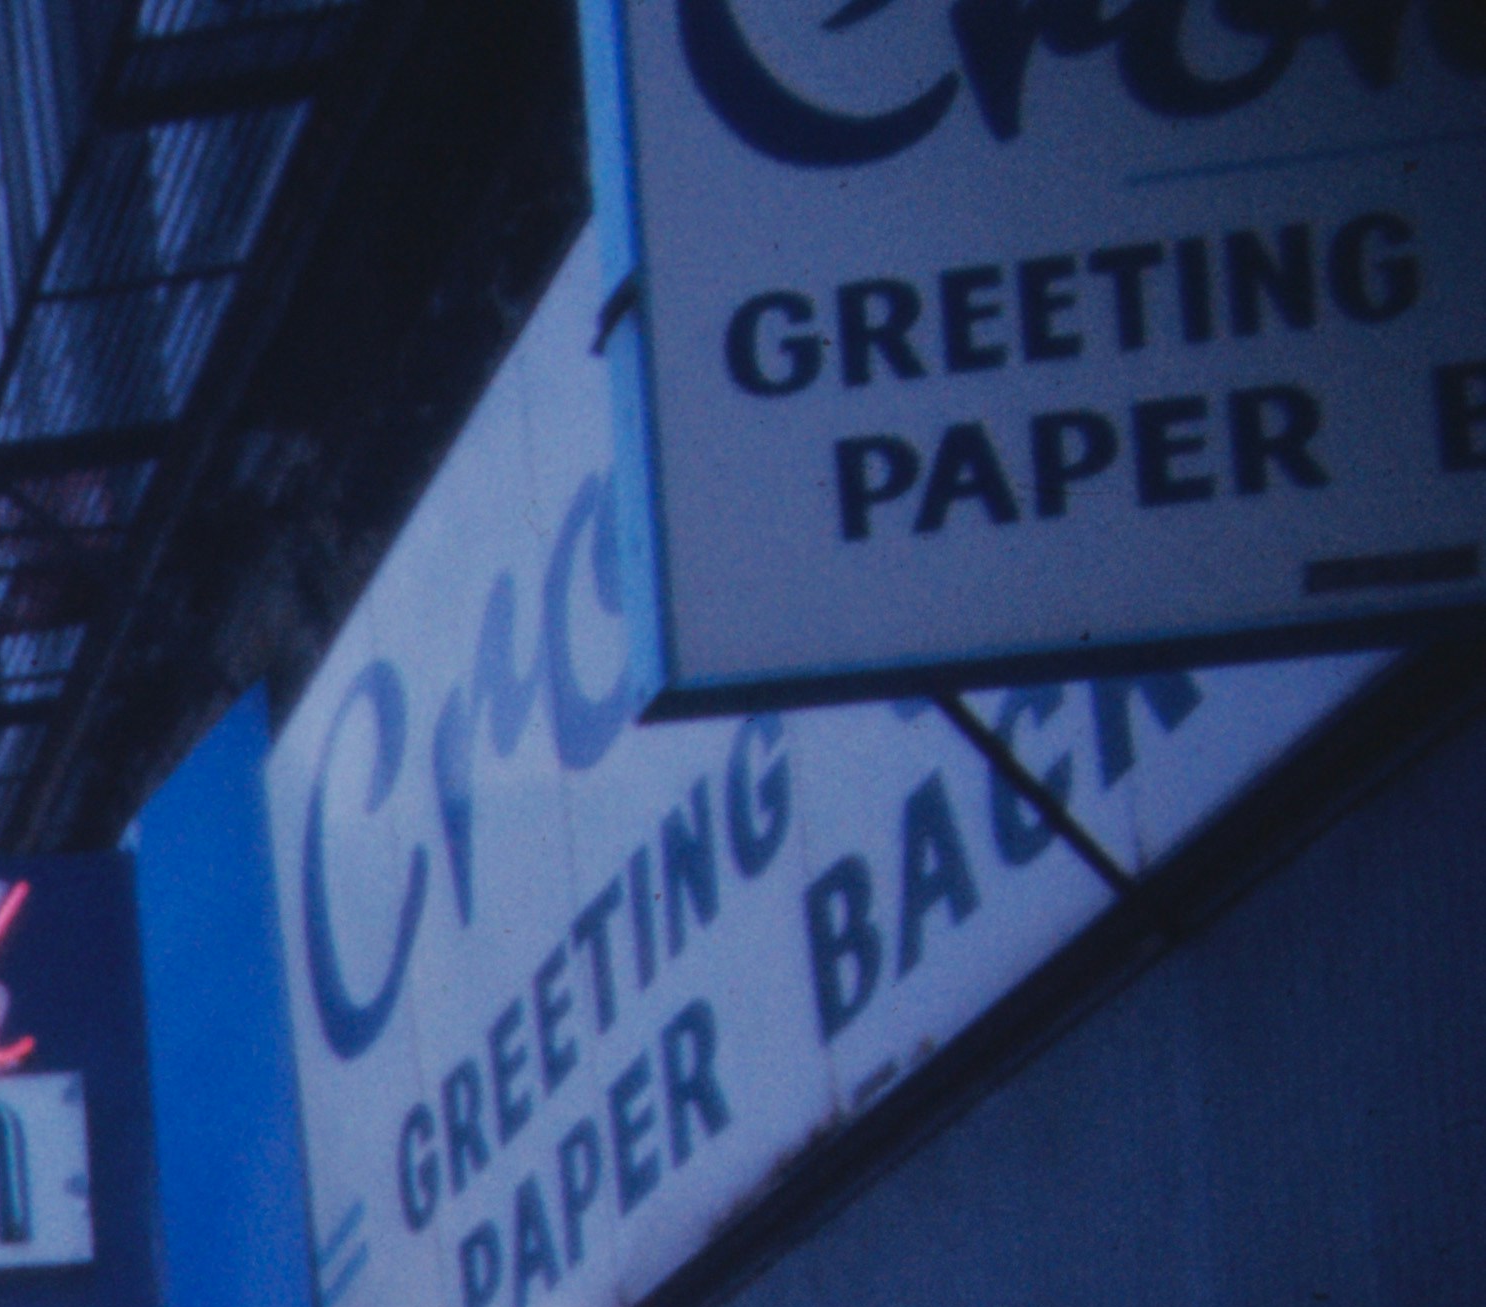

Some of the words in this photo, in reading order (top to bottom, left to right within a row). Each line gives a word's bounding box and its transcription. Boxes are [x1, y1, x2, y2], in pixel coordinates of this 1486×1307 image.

[724, 210, 1424, 398] GREETING
[833, 383, 1332, 544] PAPER
[397, 708, 793, 1234] GREETING
